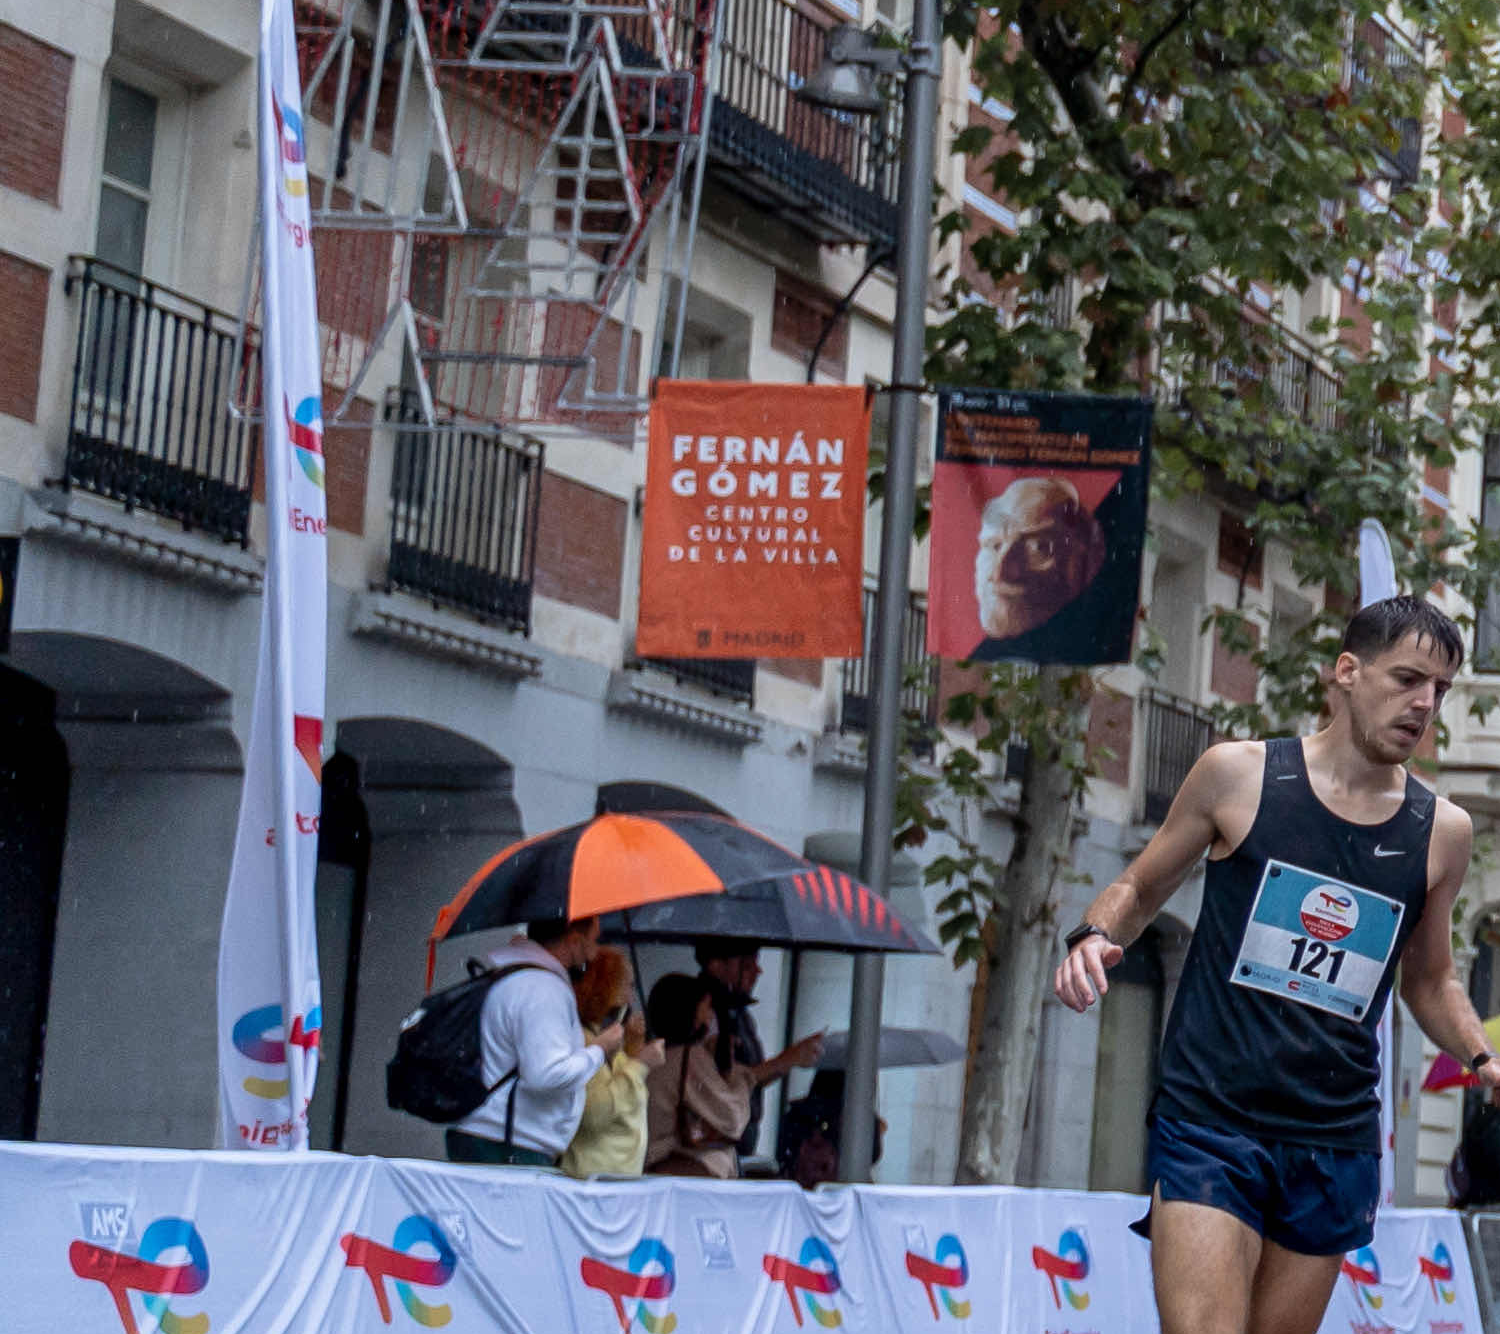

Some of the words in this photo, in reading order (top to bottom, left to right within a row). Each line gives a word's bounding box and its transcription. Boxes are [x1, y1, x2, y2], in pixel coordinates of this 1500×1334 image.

[672, 430, 844, 466] FERNÁN
[671, 462, 843, 499] GÓMEZ
[705, 505, 809, 523] CENTRO
[688, 525, 822, 543] CULTURAL
[668, 545, 700, 563] DE
[715, 546, 748, 563] LA
[763, 547, 839, 564] VILLA
[1288, 936, 1347, 985] 121
